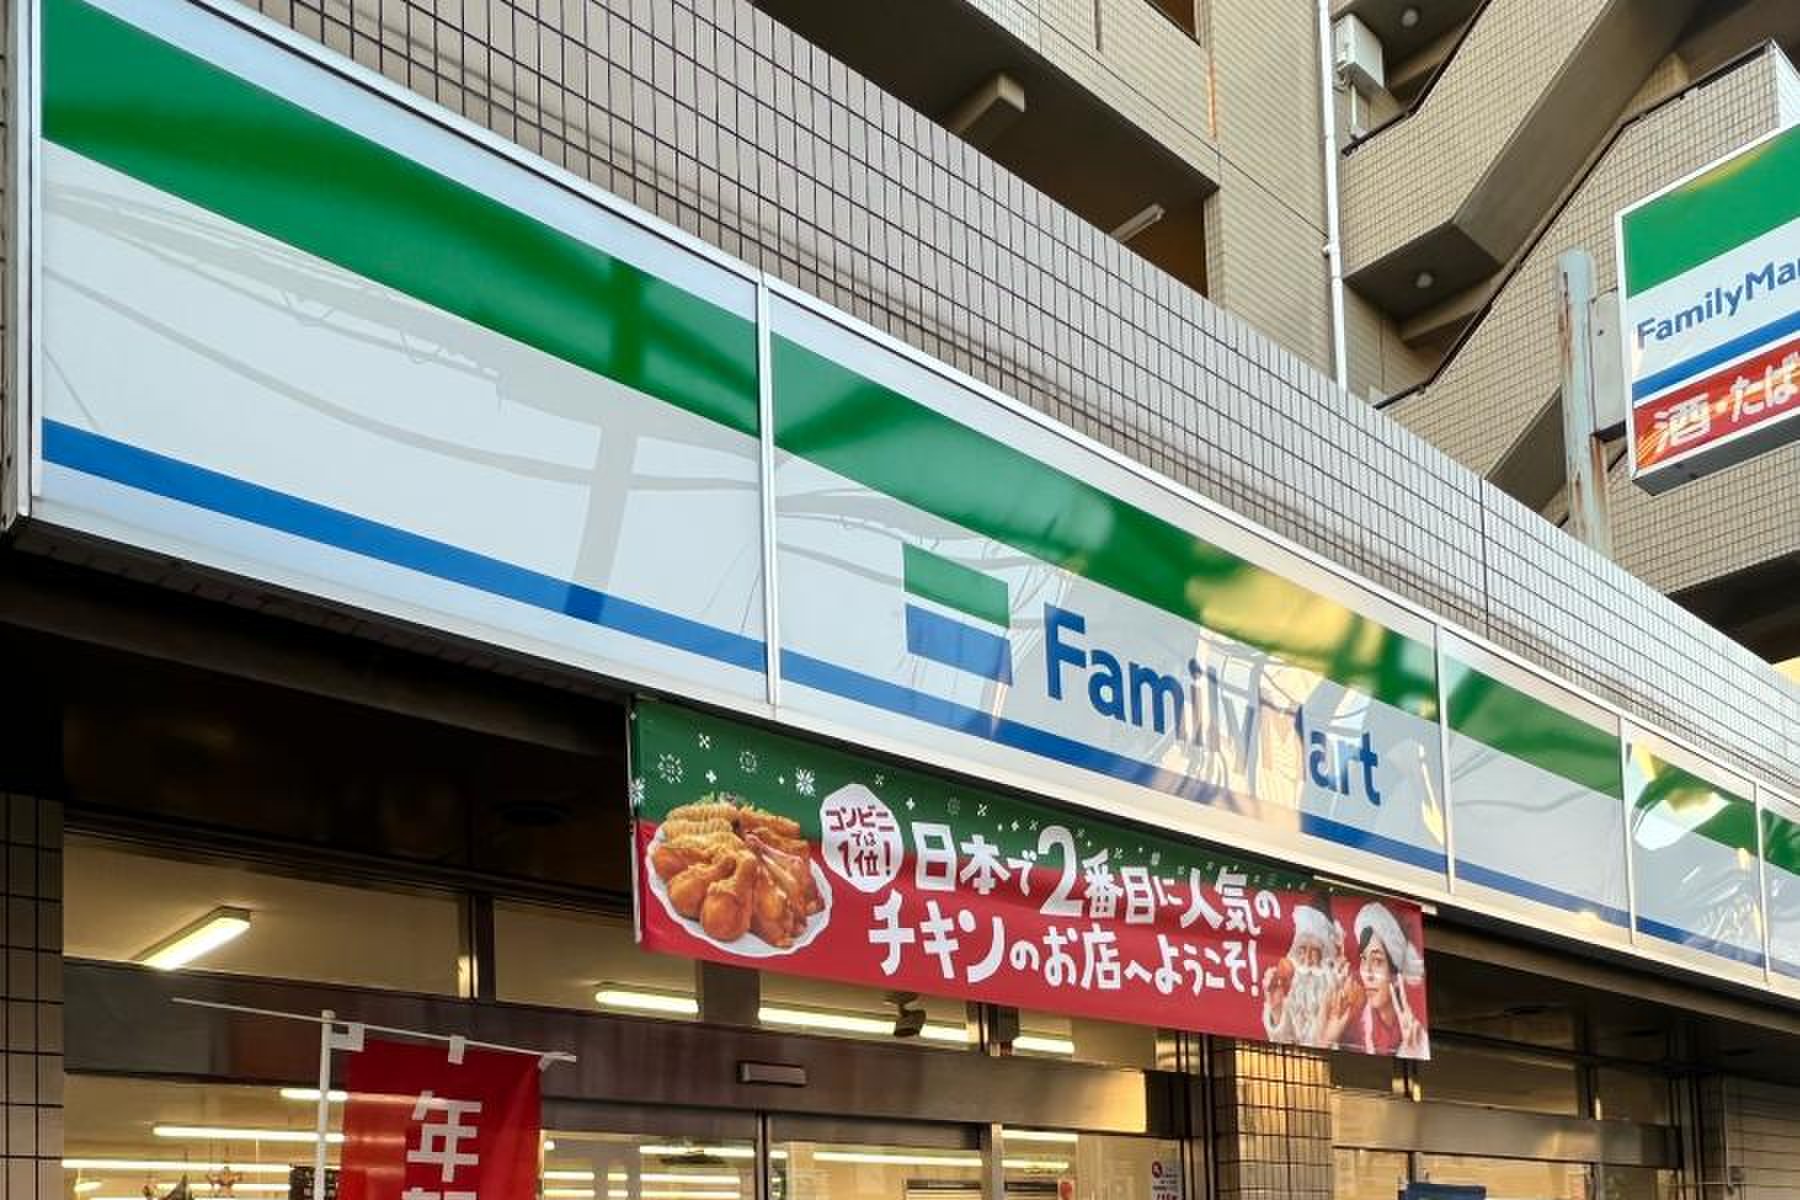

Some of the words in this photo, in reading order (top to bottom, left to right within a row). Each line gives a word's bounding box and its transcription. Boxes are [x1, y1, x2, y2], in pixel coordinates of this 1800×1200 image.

[826, 804, 895, 833] コンビニ
[850, 831, 877, 847] では
[911, 821, 1281, 936] 日本で2番目に人気の
[868, 888, 1260, 997] チキンのお店へようこそ!
